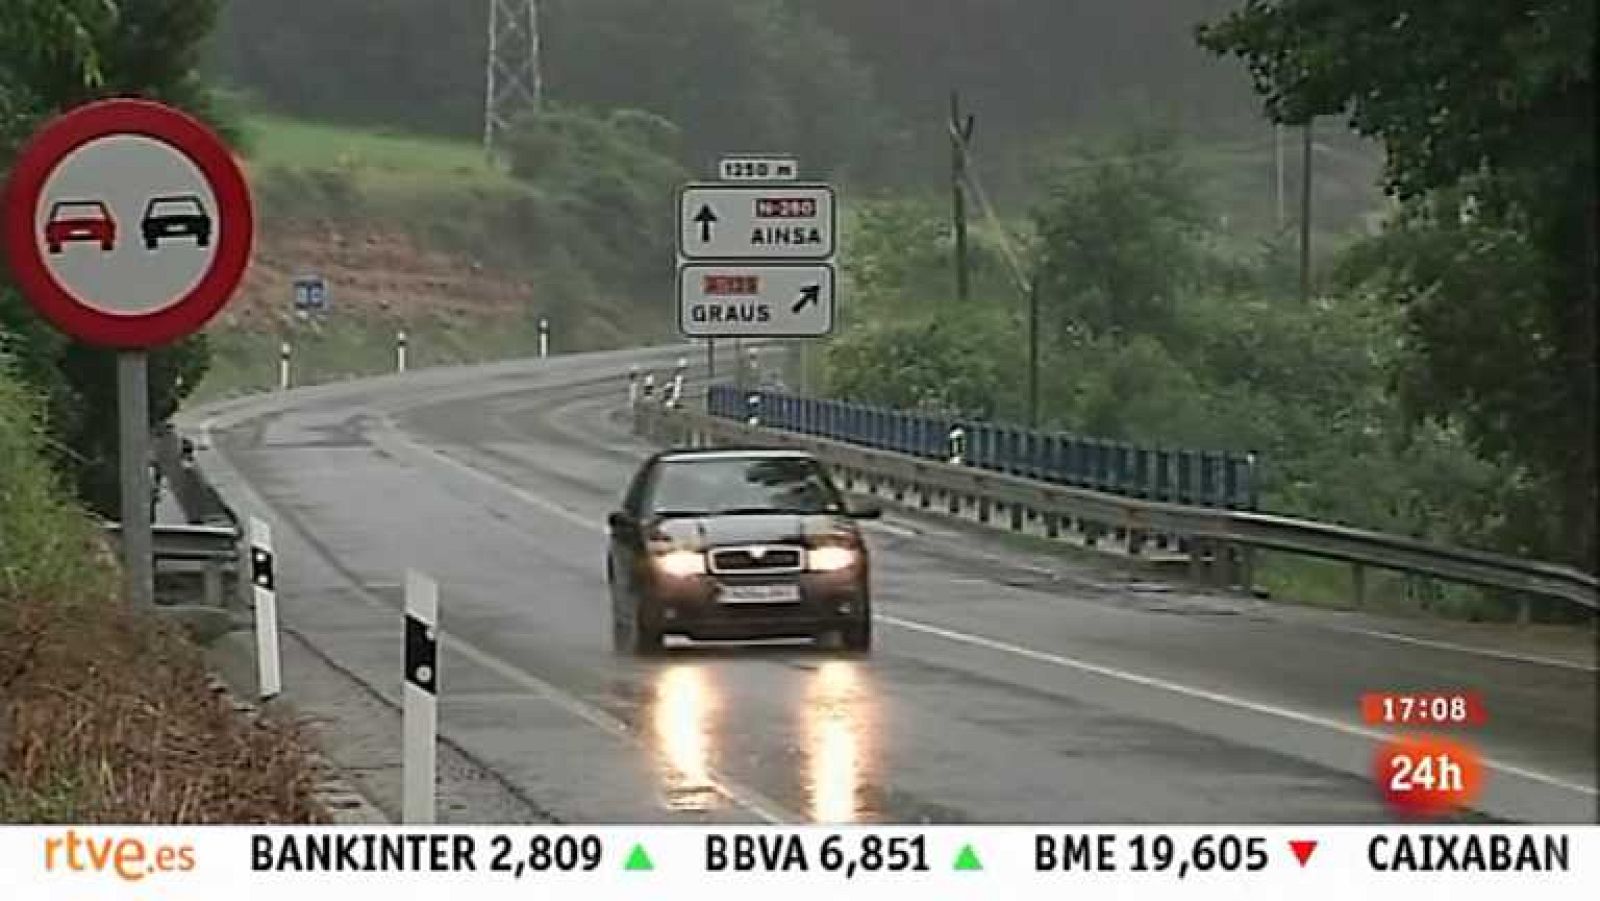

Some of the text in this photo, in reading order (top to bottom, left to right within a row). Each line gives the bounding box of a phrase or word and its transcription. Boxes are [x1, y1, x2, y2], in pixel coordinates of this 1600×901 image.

[777, 166, 791, 175] m
[751, 227, 821, 245] AINSA
[691, 303, 771, 322] GRAUS
